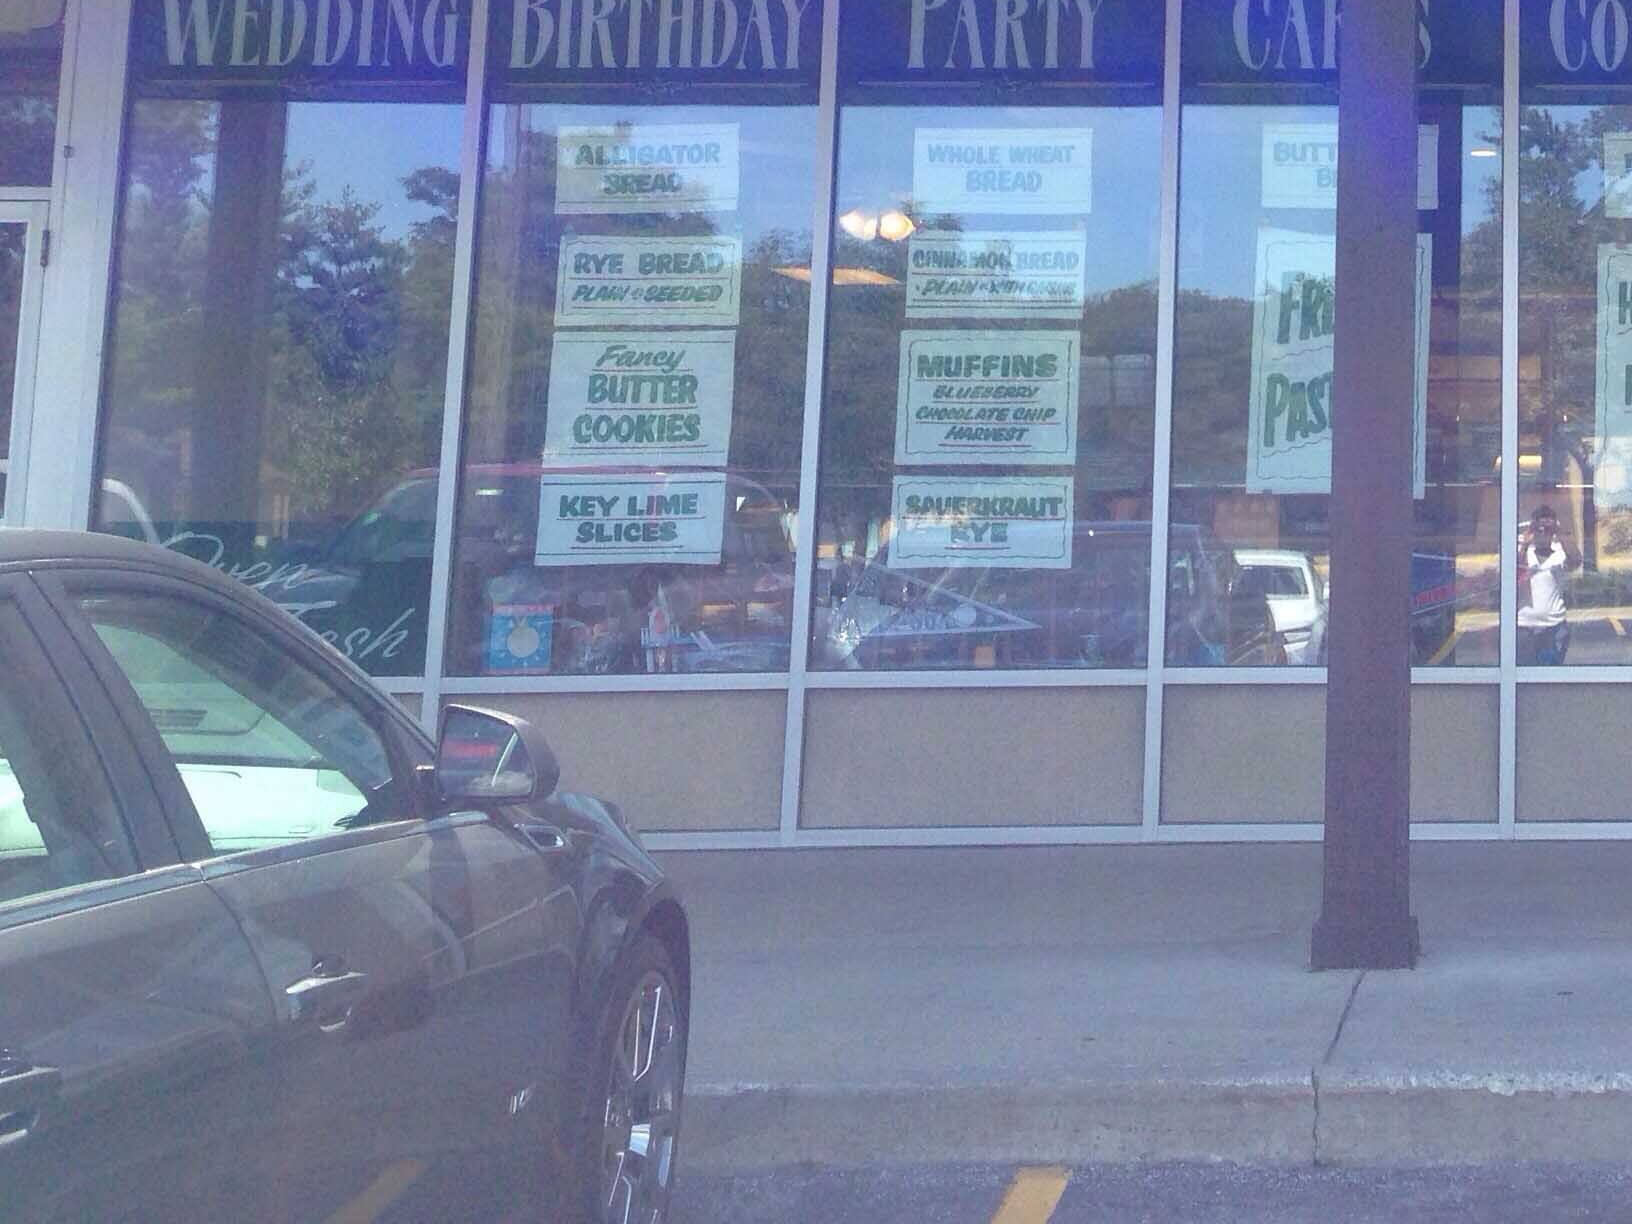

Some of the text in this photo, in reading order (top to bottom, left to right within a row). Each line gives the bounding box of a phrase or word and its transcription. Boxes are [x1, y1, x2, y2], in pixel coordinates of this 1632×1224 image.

[576, 143, 720, 165] ALLIGATOR
[928, 144, 1075, 164] WHOLE WHEAT
[966, 169, 1042, 193] BREAD
[573, 252, 723, 275] RYE BREAD
[1015, 250, 1079, 270] BREAD
[572, 284, 630, 302] PLAIN
[644, 284, 723, 303] SEEDED
[596, 345, 686, 373] Fancy
[916, 353, 1058, 378] MUFFINS
[587, 374, 698, 405] BUTTER
[932, 385, 1040, 400] BLUEBERRY
[915, 406, 1057, 422] CHOCOLATE CHIP
[572, 414, 701, 443] COOKIES
[944, 426, 1030, 443] HARVEST
[559, 494, 698, 518] KEY LIME
[905, 494, 1064, 518] SAUERKRAUT
[576, 521, 678, 544] SLICES
[950, 522, 1009, 544] RYE
